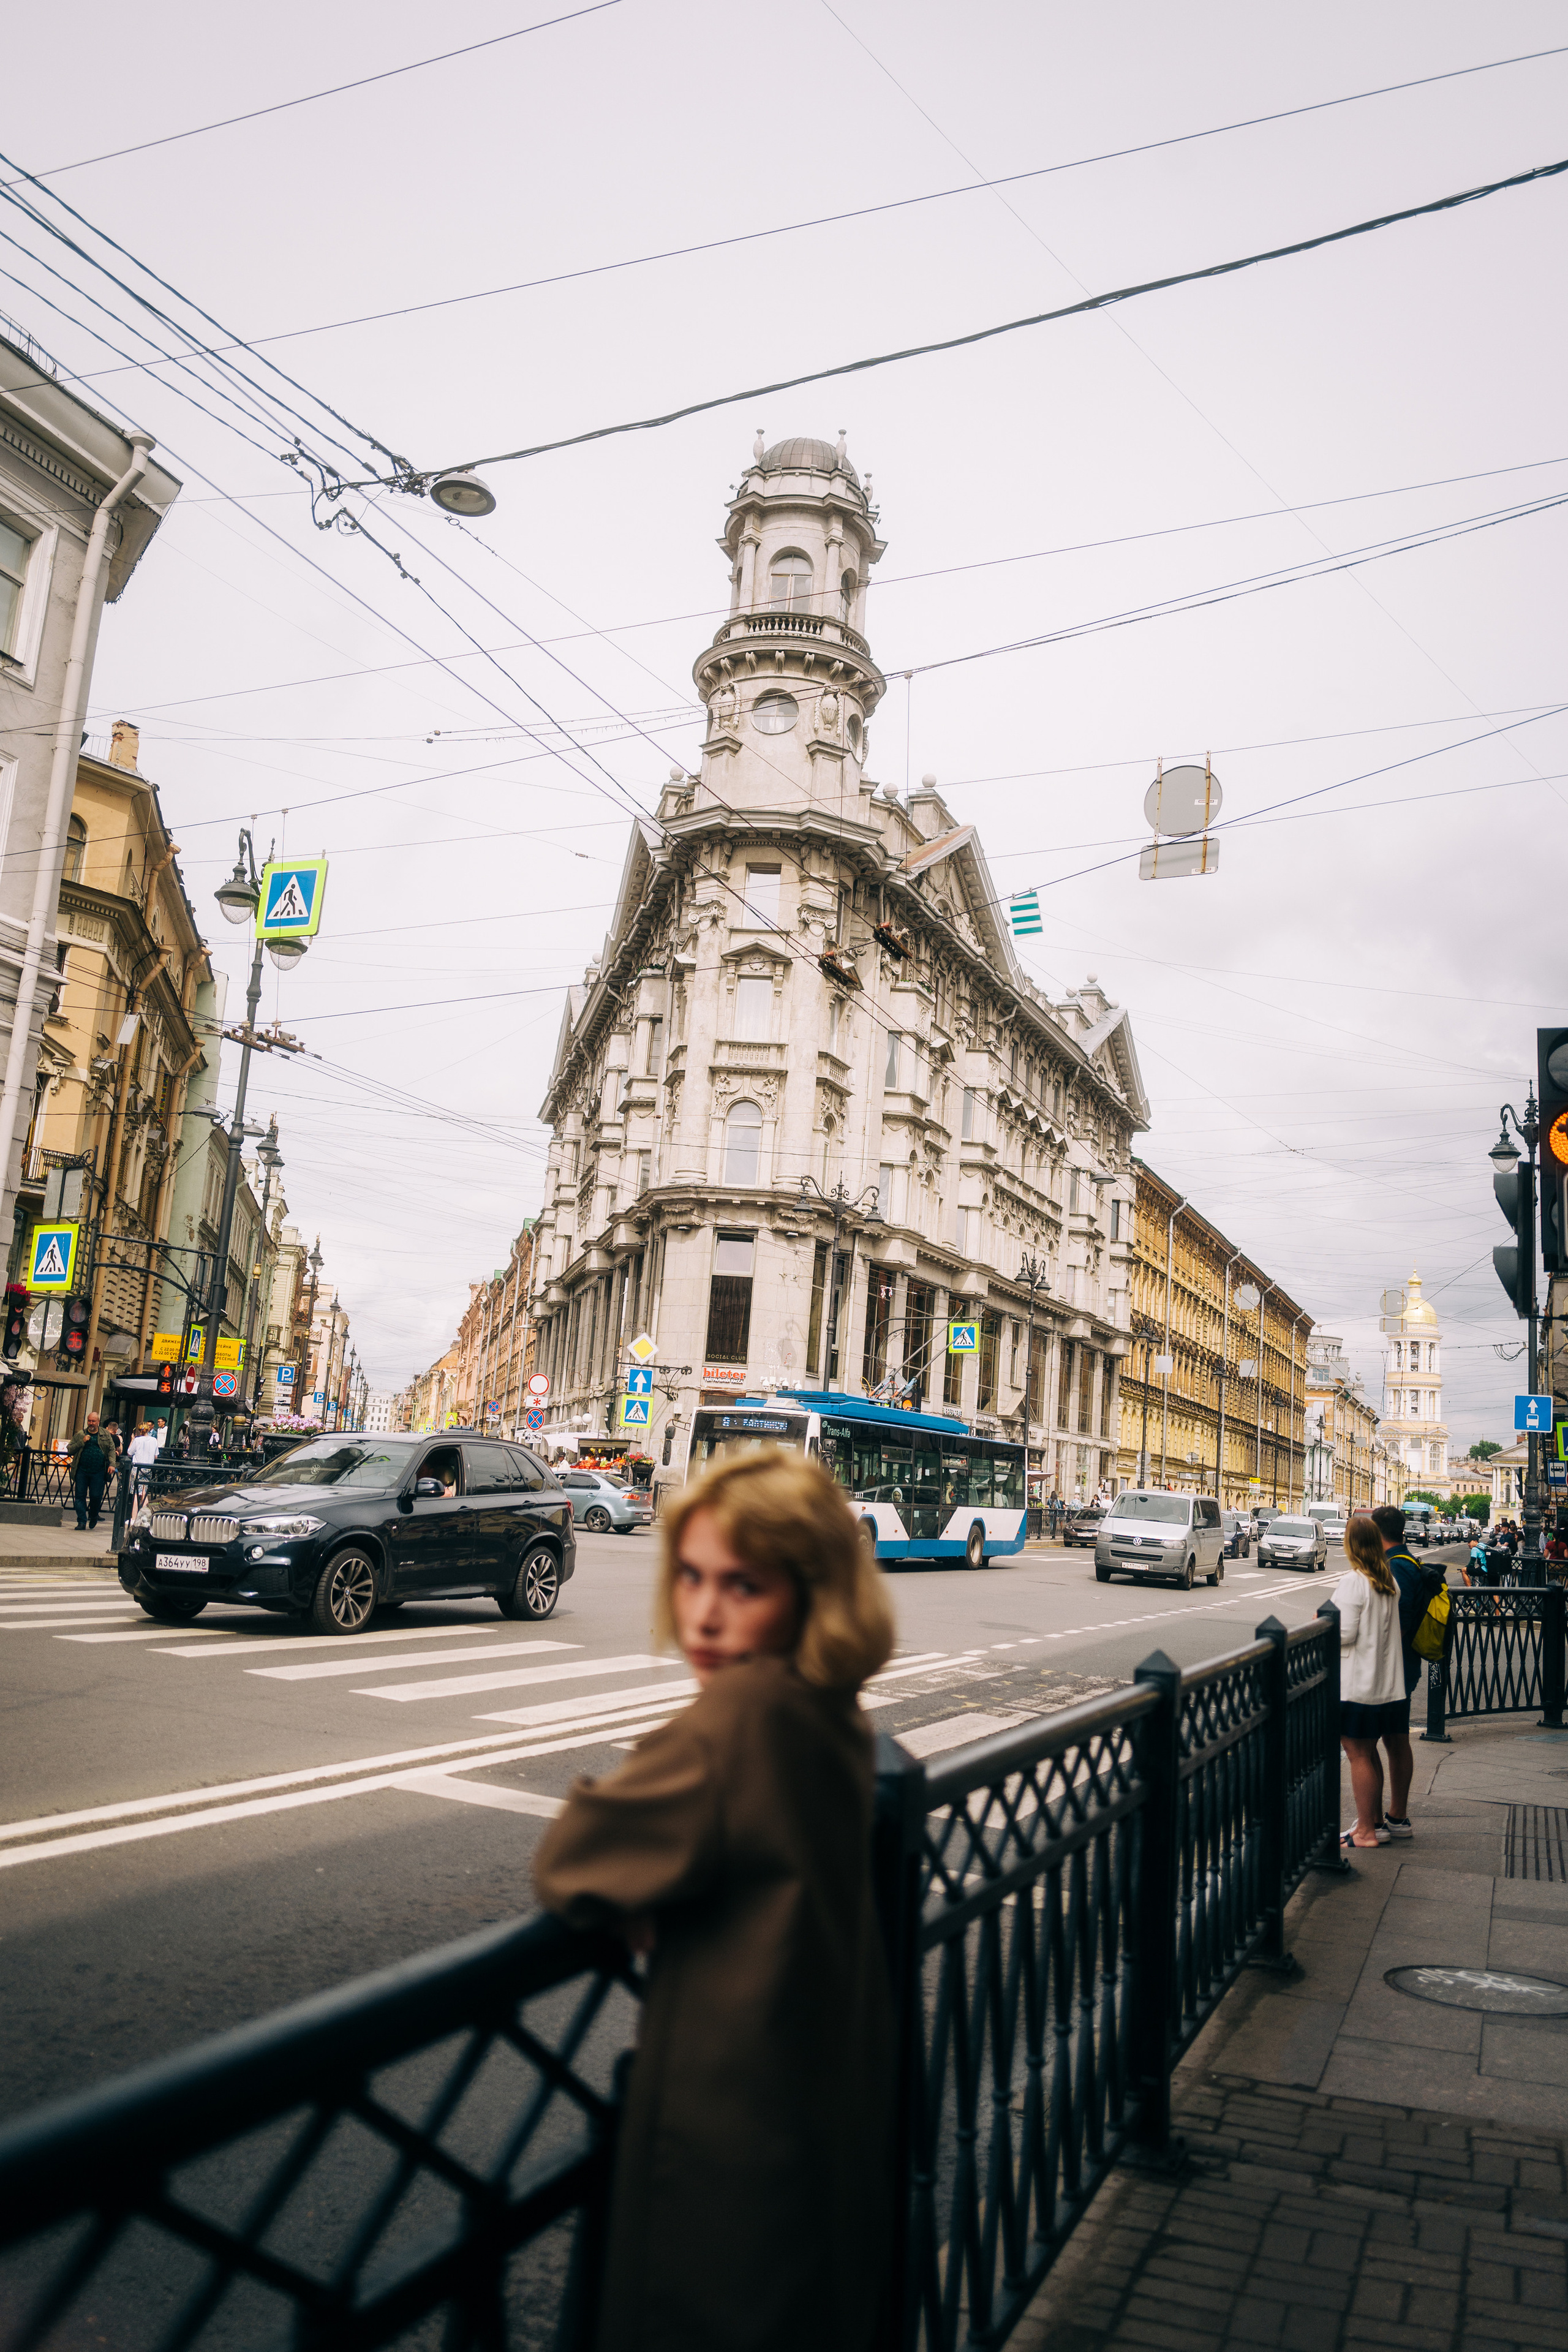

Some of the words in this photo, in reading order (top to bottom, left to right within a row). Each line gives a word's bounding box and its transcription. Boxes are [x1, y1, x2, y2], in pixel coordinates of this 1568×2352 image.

[67, 1332, 82, 1348] 36
[703, 1367, 746, 1379] bileter
[160, 1382, 171, 1393] 36
[827, 1425, 851, 1438] Trans-Alfa
[192, 1558, 206, 1567] 198
